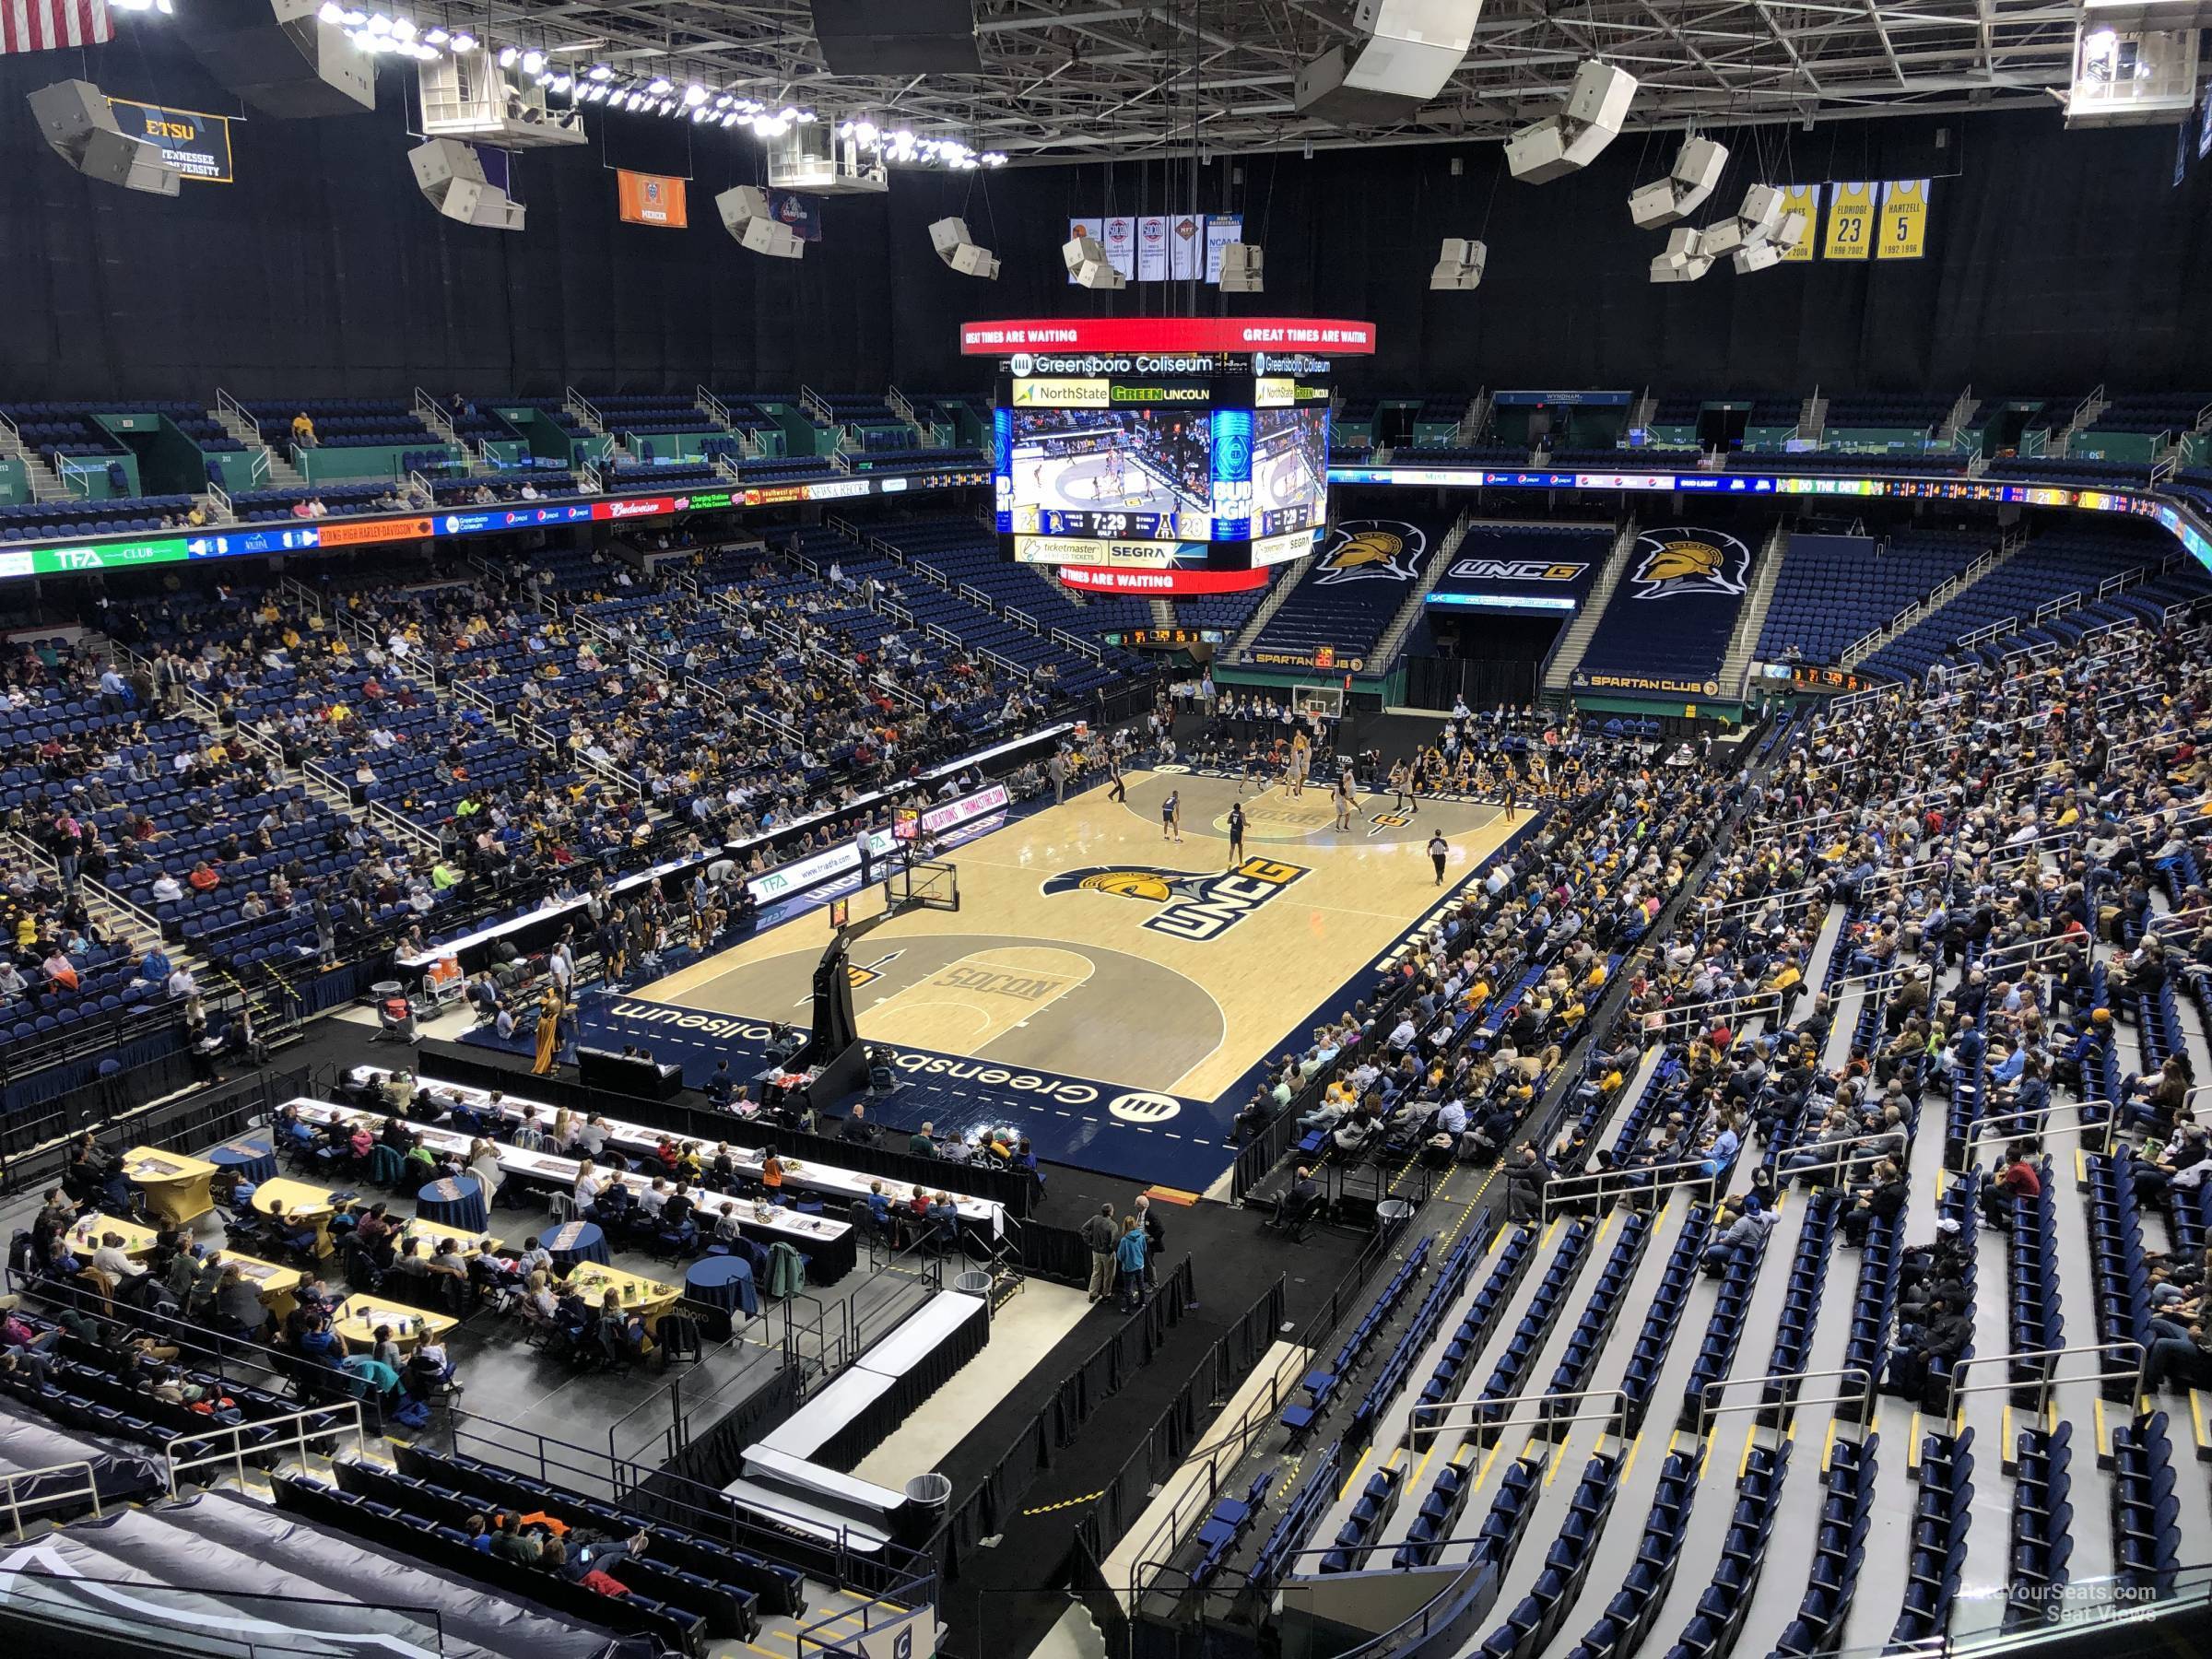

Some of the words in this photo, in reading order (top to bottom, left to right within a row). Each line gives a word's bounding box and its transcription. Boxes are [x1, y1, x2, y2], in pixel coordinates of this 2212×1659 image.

[146, 119, 194, 140] ETSU
[1837, 206, 1867, 215] ELDRIDGE
[1888, 203, 1920, 214] HARTZELL
[1837, 218, 1862, 242] 23
[1897, 217, 1909, 241] 5
[1209, 238, 1232, 246] NCAA
[982, 331, 1004, 344] TIMES
[1006, 330, 1025, 343] ARE
[1028, 329, 1077, 343] WAITING
[1243, 328, 1284, 342] GREAT
[1287, 329, 1320, 342] TIMES
[1322, 330, 1339, 343] ARE
[1341, 331, 1367, 344] WAITING
[1036, 356, 1131, 372] Greensboro
[1135, 356, 1213, 372] Coliseum
[1265, 357, 1302, 372] Greensboro
[1303, 358, 1330, 373] Coliseum
[1041, 387, 1107, 400] NorthState
[1112, 386, 1163, 401] GREEN
[1164, 389, 1210, 400] LINCOLN
[1266, 385, 1294, 399] NorthState
[1295, 385, 1313, 400] GREEN
[1313, 388, 1329, 398] LINCOLN
[1425, 473, 1447, 481] Mist
[810, 486, 831, 499] NEWS
[832, 487, 839, 495] &
[840, 482, 869, 496] RECORD
[1213, 481, 1252, 500] BUD
[1798, 480, 1812, 491] DO
[1816, 480, 1835, 491] THE
[1839, 481, 1861, 492] DEW
[1886, 484, 1890, 493] 1
[1910, 485, 1915, 494] 2
[1934, 486, 1939, 494] 4
[1957, 487, 1966, 495] 14
[1981, 488, 1989, 497] 44
[692, 495, 711, 503] Charging
[2038, 492, 2050, 504] 21
[2078, 494, 2087, 507] A
[2097, 498, 2110, 510] 20
[610, 502, 659, 517] Budweiser
[1021, 513, 1040, 530] 21
[1091, 513, 1127, 531] 7:29
[1181, 518, 1204, 537] 20
[321, 528, 342, 539] RIDING
[343, 526, 358, 538] HIGH
[1044, 543, 1097, 554] ticketmaster
[1290, 535, 1310, 549] SEGRA
[54, 549, 104, 570] TFA
[123, 548, 154, 559] CLUB
[1112, 546, 1166, 559] SEGRA
[1453, 561, 1580, 579] UNCG
[1091, 572, 1114, 586] ARE
[1116, 574, 1173, 588] WAITING
[1256, 653, 1313, 666] SPARTAN
[1317, 654, 1331, 667] 26
[1591, 675, 1660, 689] SPARTAN
[1661, 680, 1701, 693] CLUB
[899, 809, 918, 820] 7:29
[929, 806, 959, 828] LOCATIONS
[961, 788, 1005, 816] THOMASTIRE.COM
[759, 875, 789, 893] TFA
[801, 853, 852, 879] www.triadfa.com
[870, 835, 887, 850] FA
[1153, 859, 1301, 939] UNCG
[933, 967, 1064, 1001] SOCON
[897, 1633, 909, 1659] C
